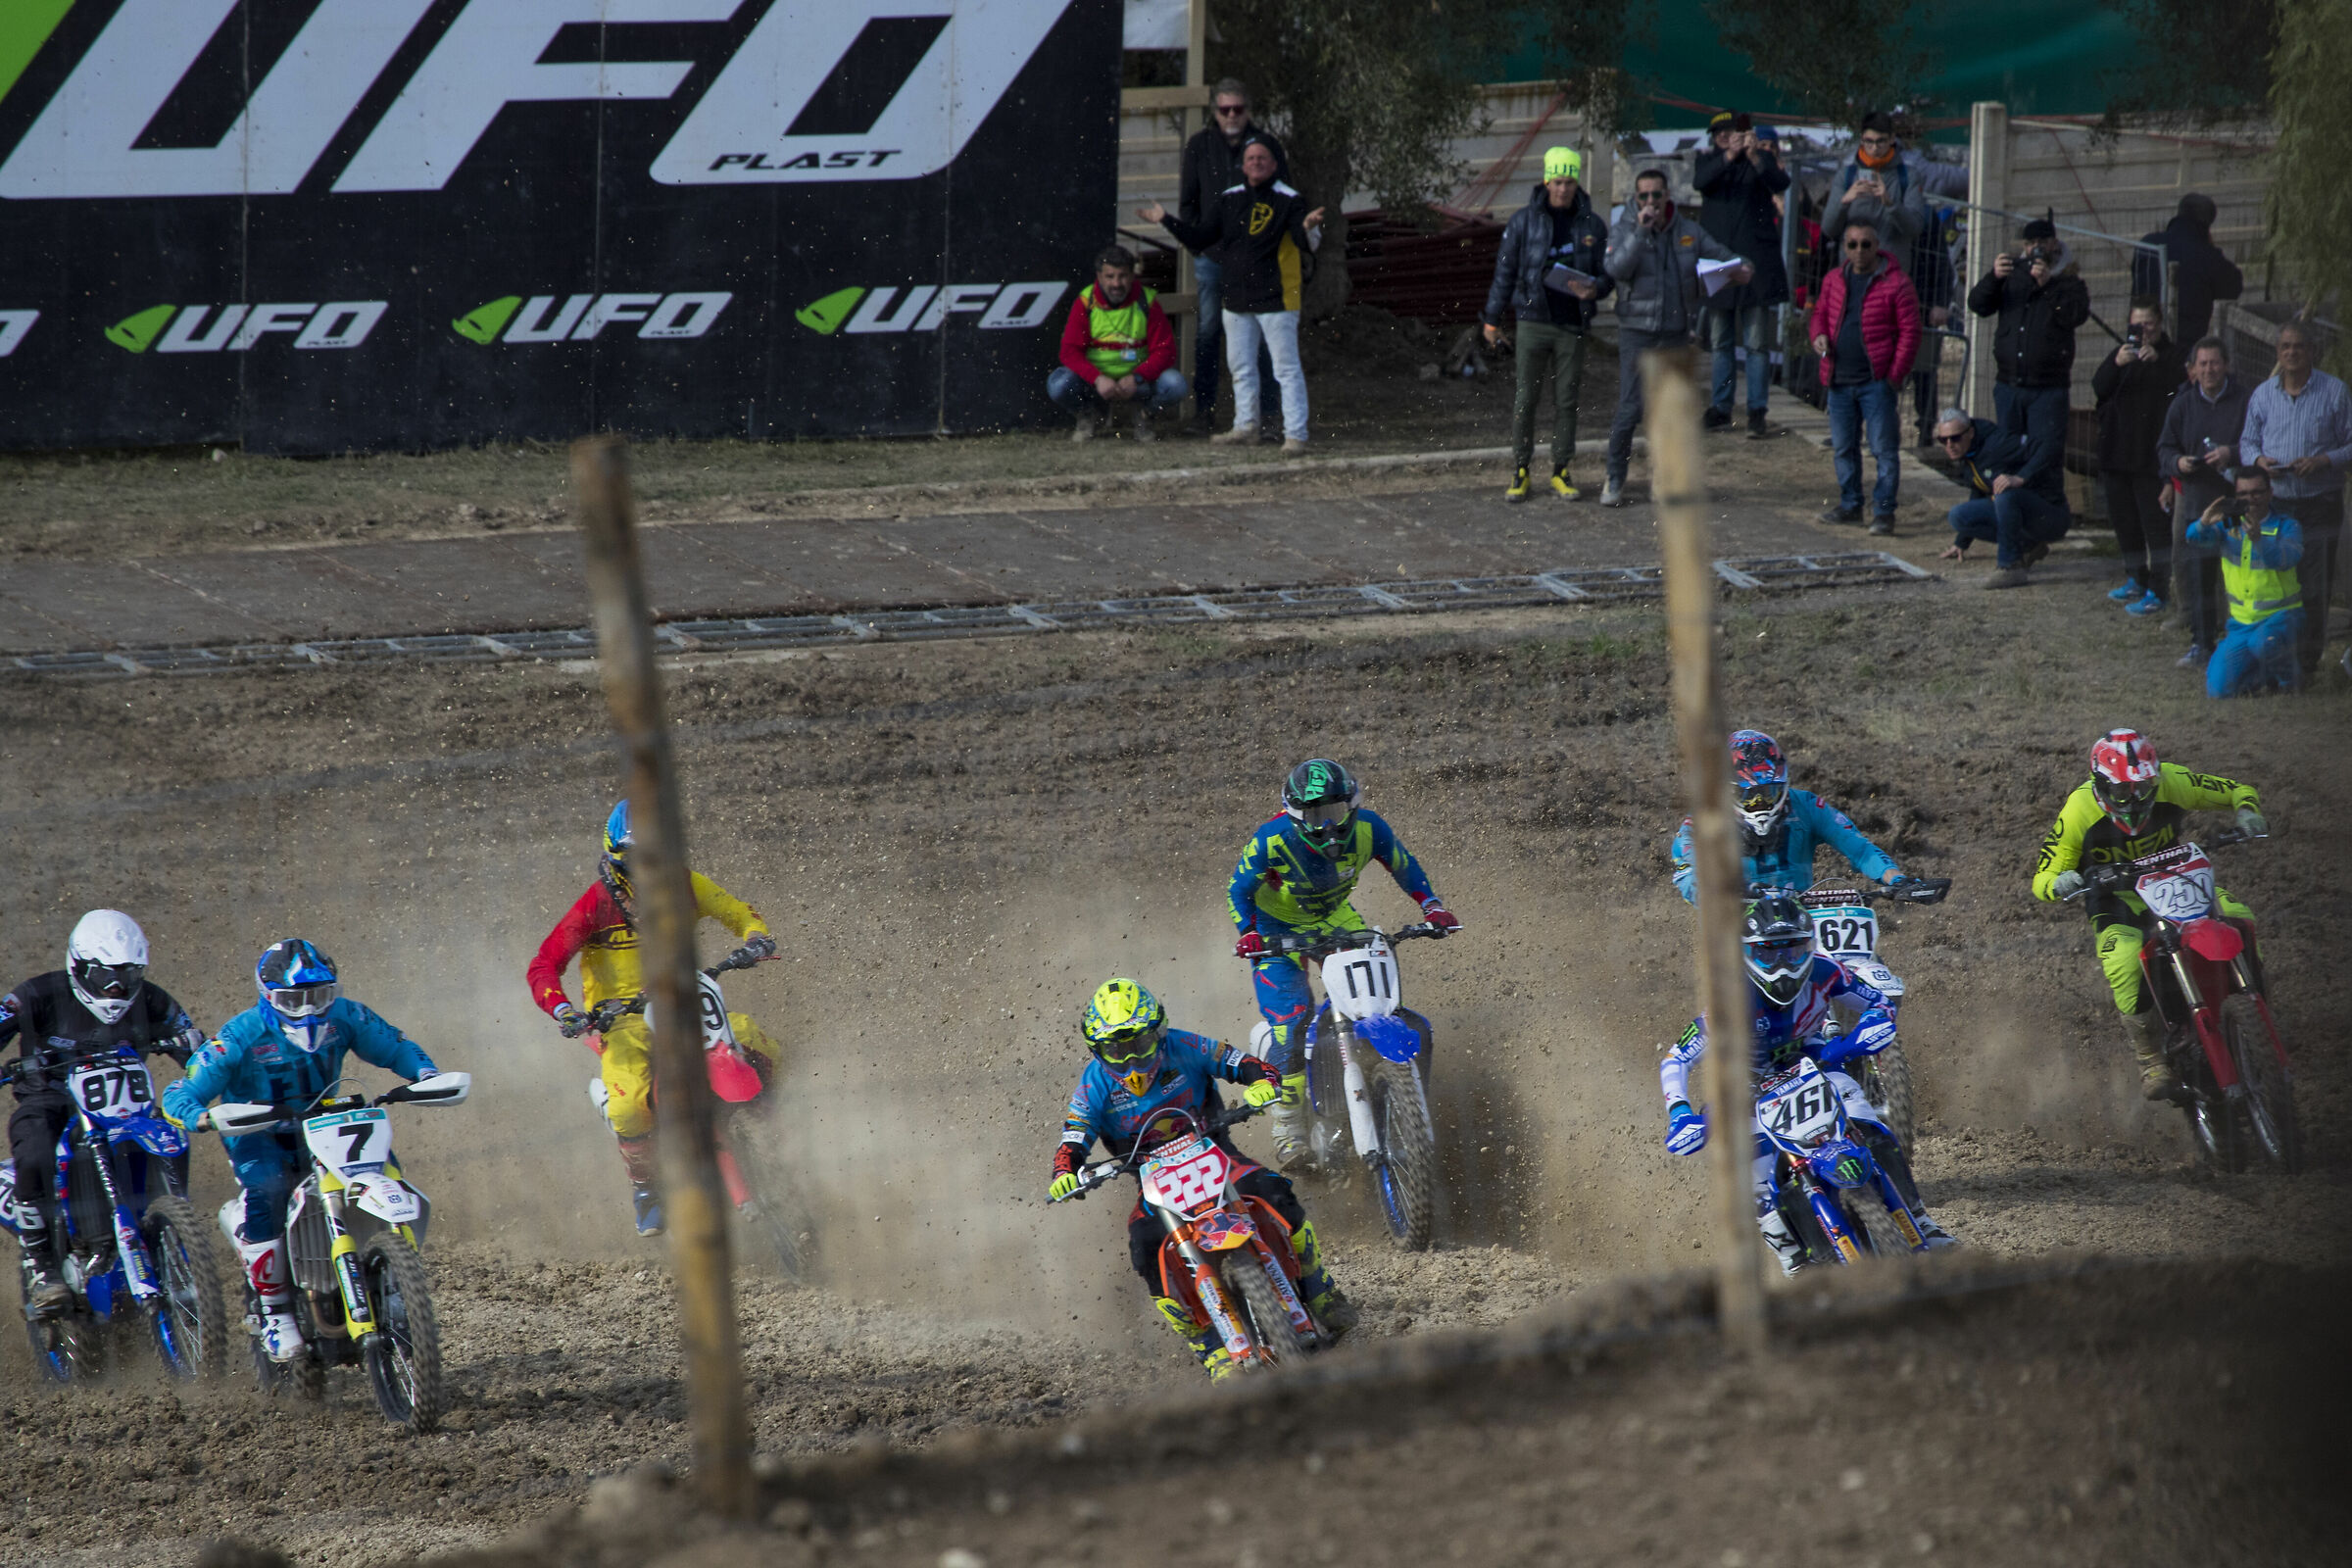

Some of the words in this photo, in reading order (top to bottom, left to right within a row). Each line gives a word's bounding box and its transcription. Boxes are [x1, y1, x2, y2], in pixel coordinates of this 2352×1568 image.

[708, 149, 903, 172] PLAST
[155, 301, 389, 353] UFO
[502, 292, 733, 342] UFO
[844, 281, 1069, 333] UFO
[1820, 918, 1874, 952] 621
[1345, 960, 1392, 999] 171
[82, 1069, 152, 1111] 878
[1771, 1081, 1833, 1134] 461
[338, 1122, 374, 1163] 7
[1156, 1153, 1224, 1213] 222
